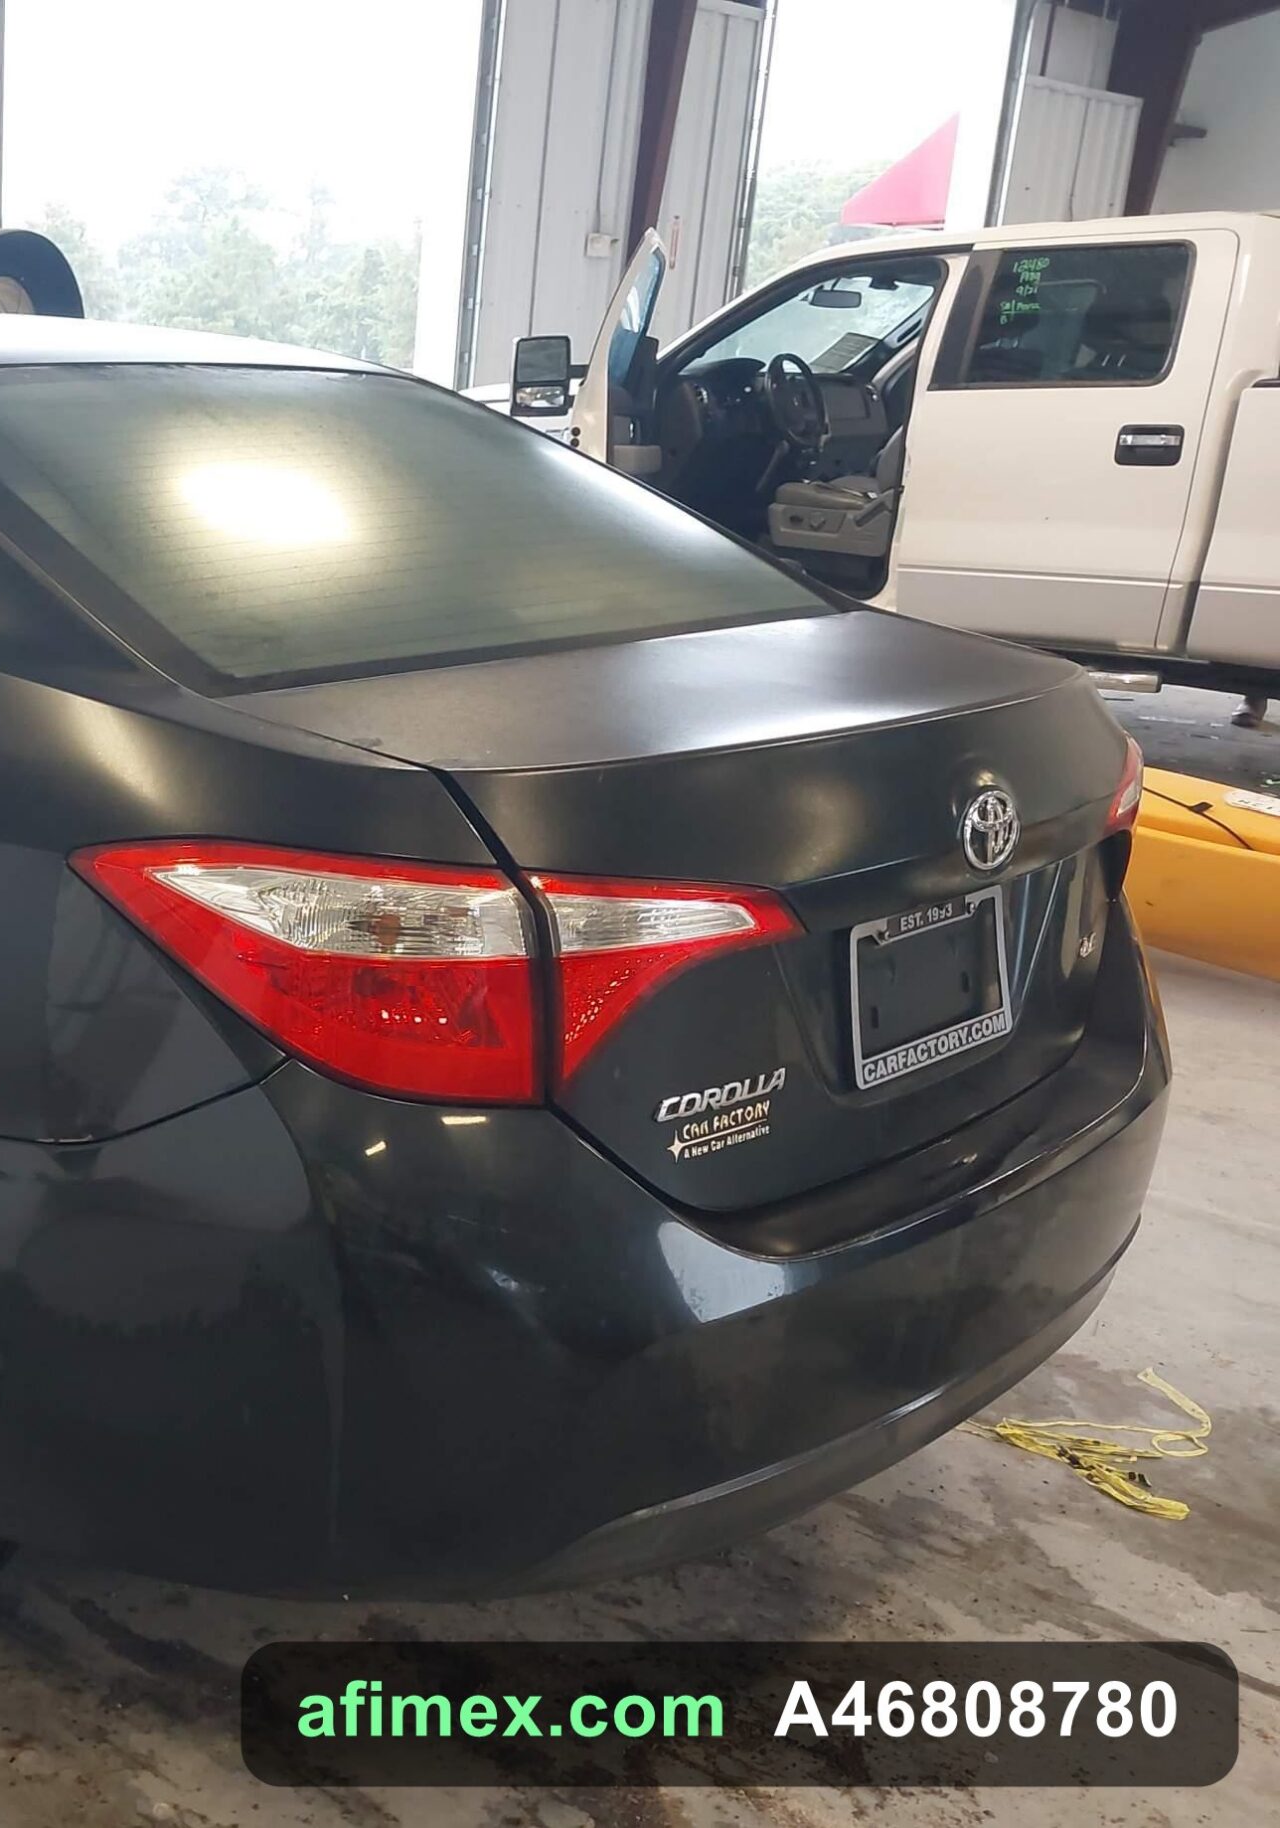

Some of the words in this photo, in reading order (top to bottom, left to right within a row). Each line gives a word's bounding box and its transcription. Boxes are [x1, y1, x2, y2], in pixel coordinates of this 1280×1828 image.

[900, 911, 924, 931] EST.
[863, 1013, 1006, 1083] CARFACTORY.COM
[656, 1067, 786, 1123] COROLLA
[683, 1120, 709, 1139] CAR
[713, 1100, 770, 1131] FACTORY
[684, 1149, 691, 1159] A
[692, 1144, 709, 1157] New
[711, 1139, 725, 1152] Car
[727, 1125, 770, 1146] Alternative
